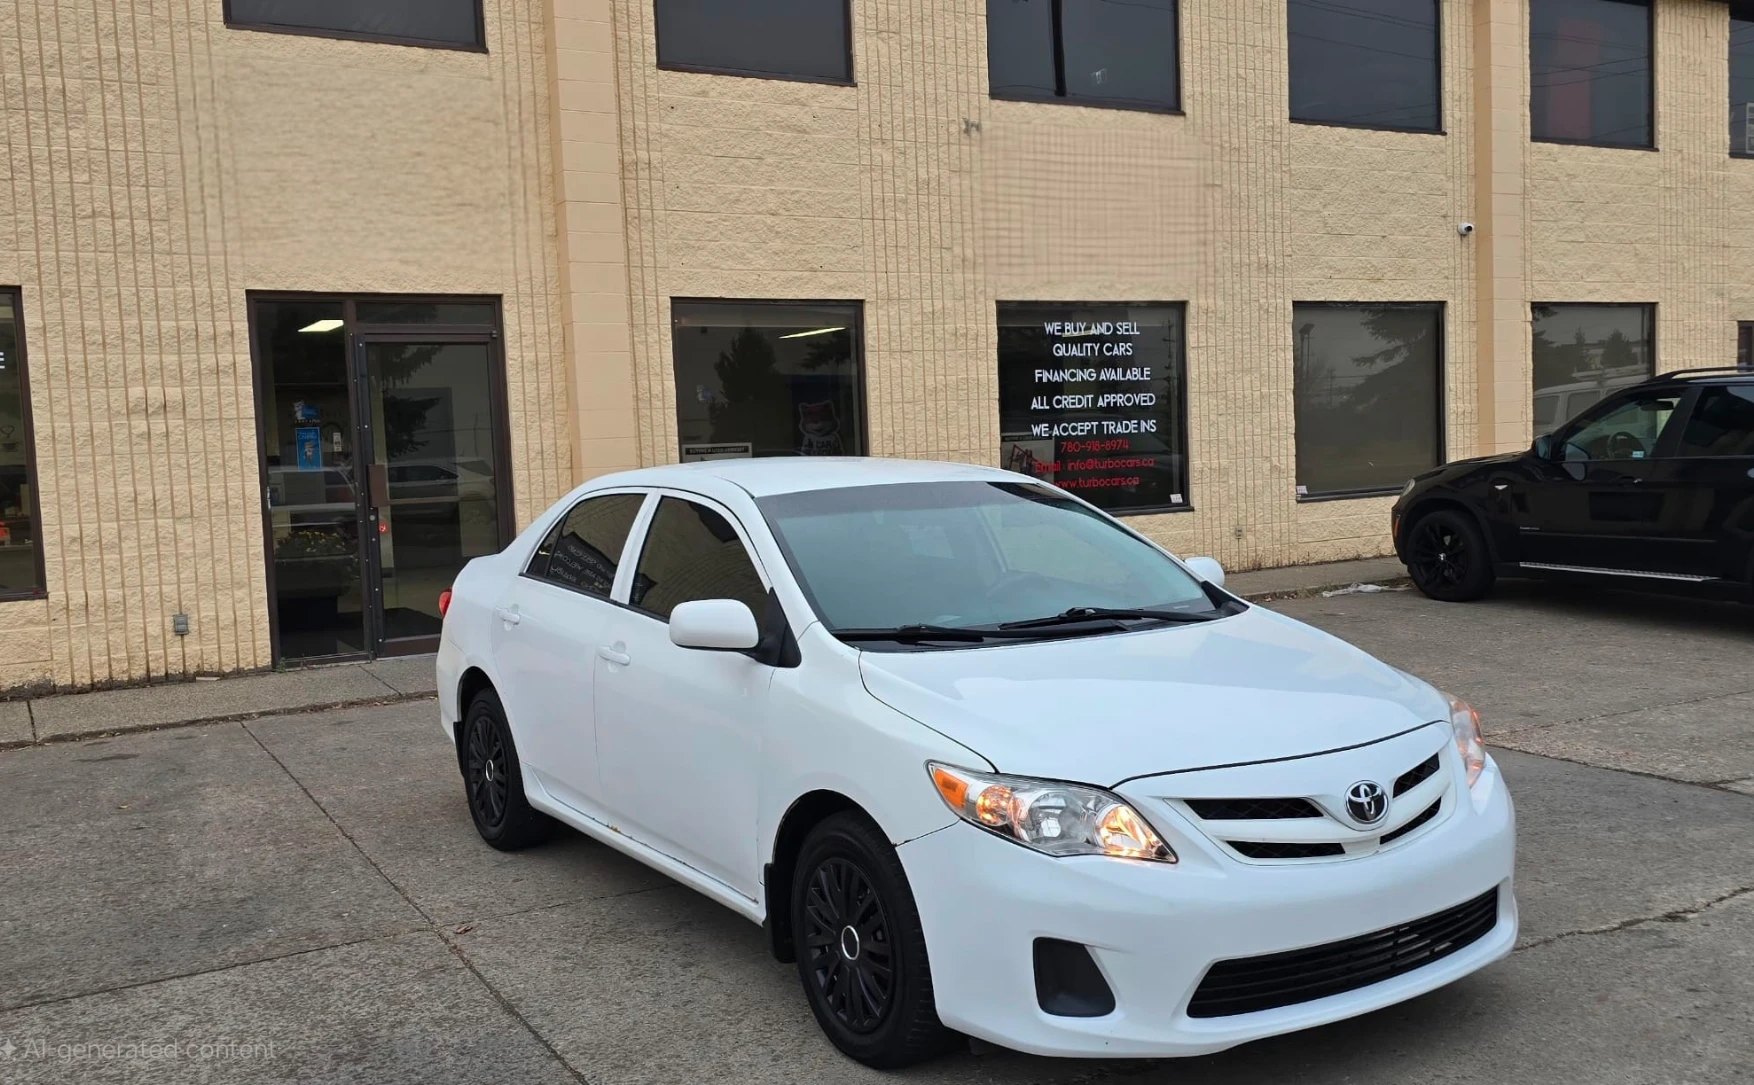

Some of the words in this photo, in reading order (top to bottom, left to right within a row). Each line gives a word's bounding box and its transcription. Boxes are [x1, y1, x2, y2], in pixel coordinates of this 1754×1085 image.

[1044, 322, 1062, 335] WE
[1064, 322, 1086, 335] BUY
[1090, 322, 1113, 335] AND
[1117, 321, 1140, 334] SELL
[1053, 343, 1100, 356] QUALITY
[1103, 343, 1133, 355] CARS
[1035, 369, 1096, 383] FINANCING
[1099, 368, 1151, 381] AVAILABLE
[1031, 396, 1049, 410] ALL
[1053, 395, 1094, 408] CREDIT
[1097, 393, 1155, 407] APPROVED
[1032, 424, 1050, 437] WE
[1052, 422, 1099, 436] ACCEPT
[1101, 421, 1137, 434] TRADE
[1140, 420, 1156, 433] INS
[1061, 440, 1130, 453] 780-918-8974
[1068, 458, 1155, 471] info@turbocars.ca
